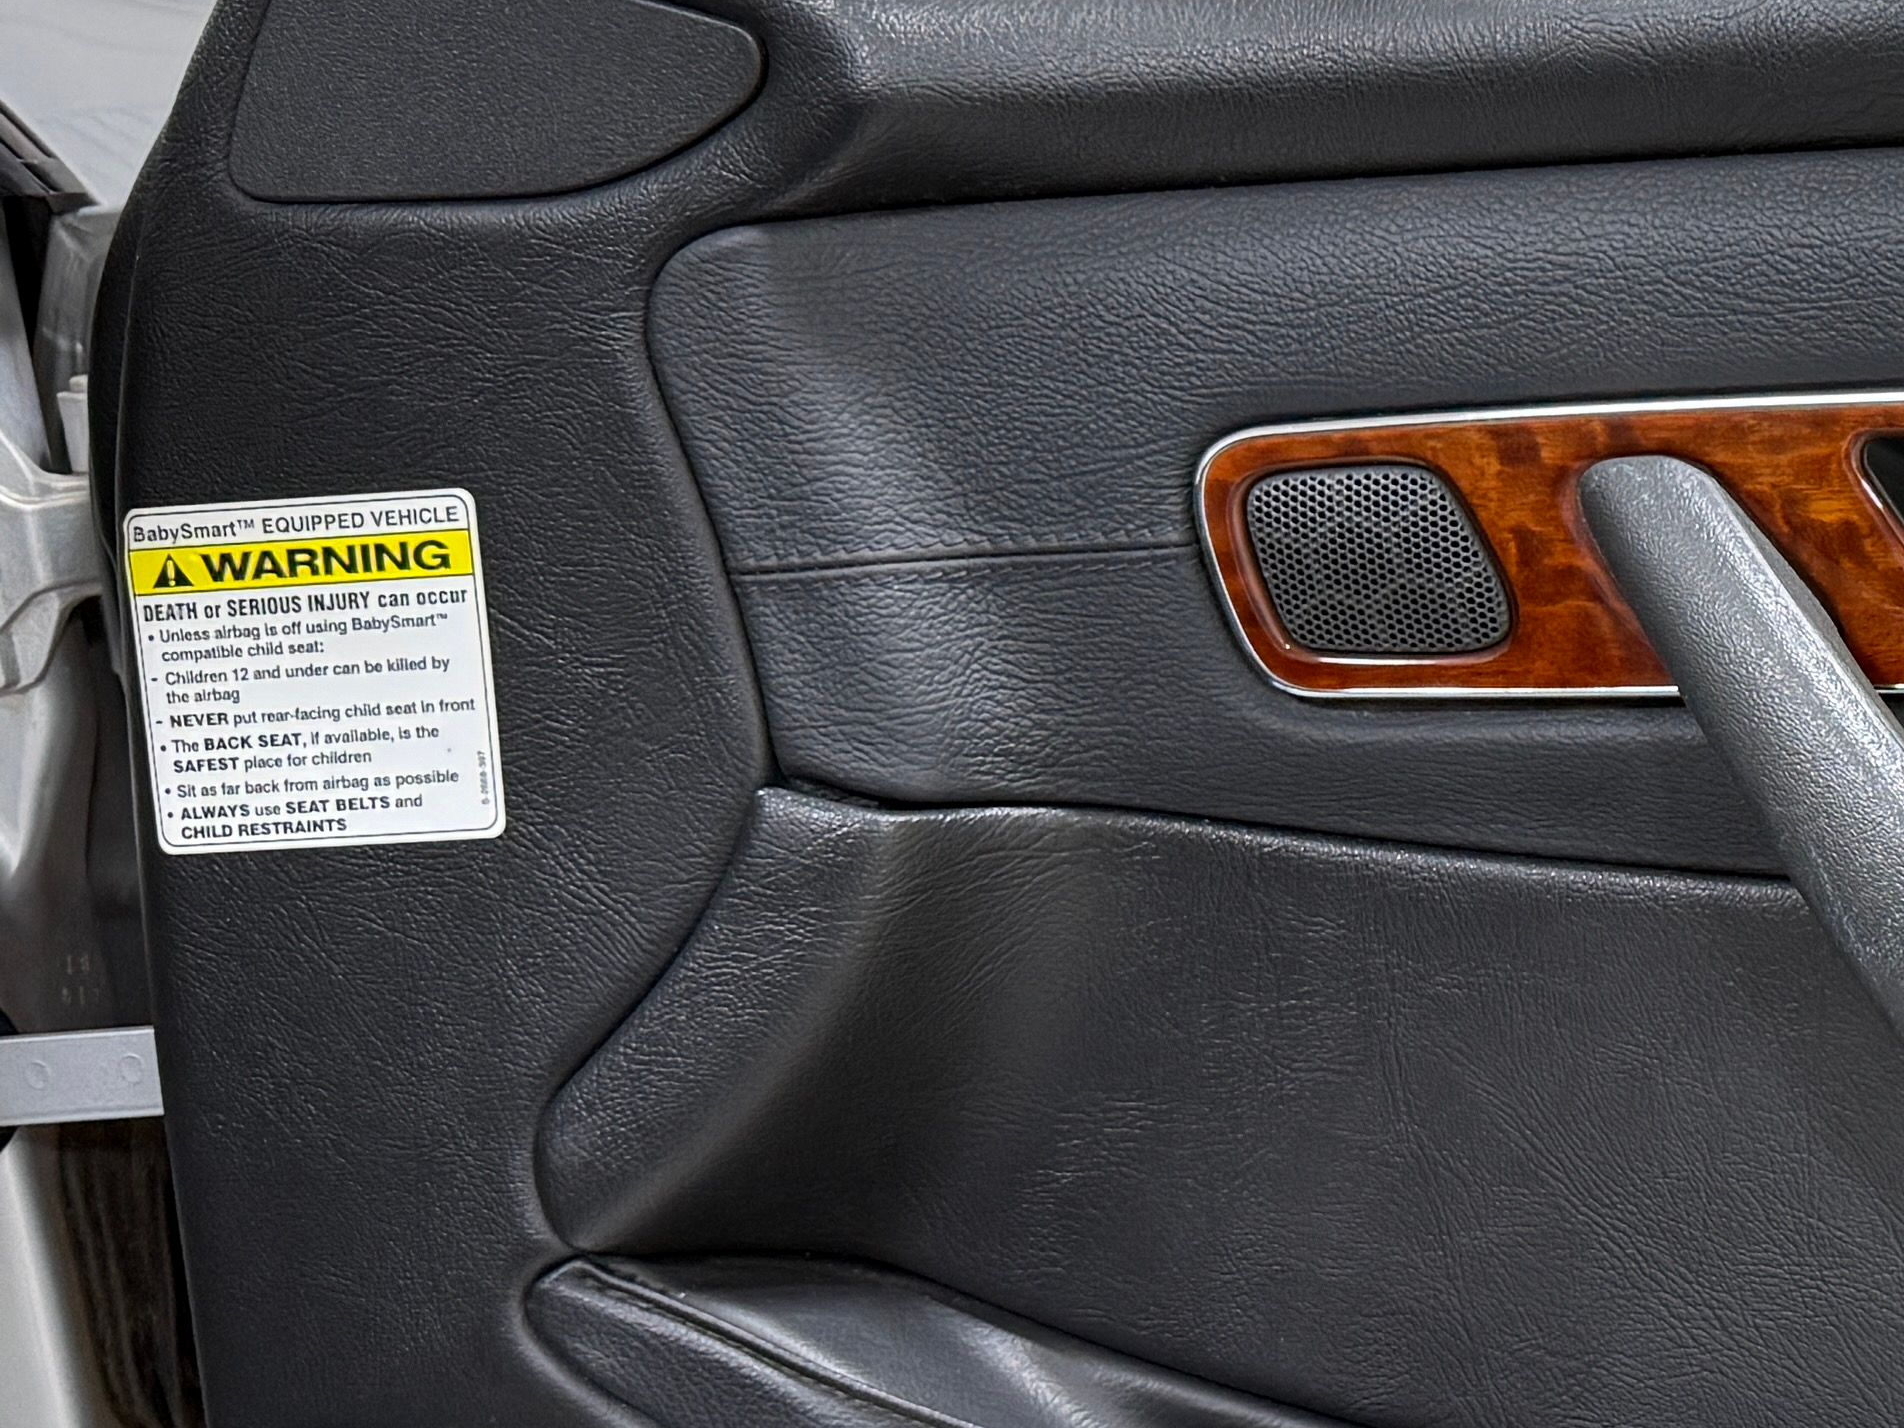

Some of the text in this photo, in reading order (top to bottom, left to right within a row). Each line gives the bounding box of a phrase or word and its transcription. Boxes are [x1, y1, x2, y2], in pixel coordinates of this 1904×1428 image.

[262, 512, 364, 534] EQUIPPED
[370, 506, 460, 527] VEHICLE
[200, 540, 451, 582] WARNING
[143, 589, 468, 622] DEATH or SERIOUS INJURY can occur
[159, 628, 210, 643] Unless
[214, 624, 261, 640] airbag
[265, 622, 278, 636] is
[281, 621, 302, 636] off
[306, 619, 348, 635] using
[161, 640, 325, 663] compatible child seat:
[165, 656, 450, 686] Children 12 and under can be killed by
[166, 689, 240, 704] the airbag
[169, 698, 476, 728] NEVER put rear-facing child seat in front
[171, 725, 439, 753] The BACK SEAT, if available, is the
[173, 751, 372, 773] SAFEST place for children
[177, 770, 459, 798] Sit as far back from airbag as possible
[181, 793, 423, 820] ALWAYS use SEAT BELTS and
[181, 818, 347, 840] CHILD RESTRAINTS
